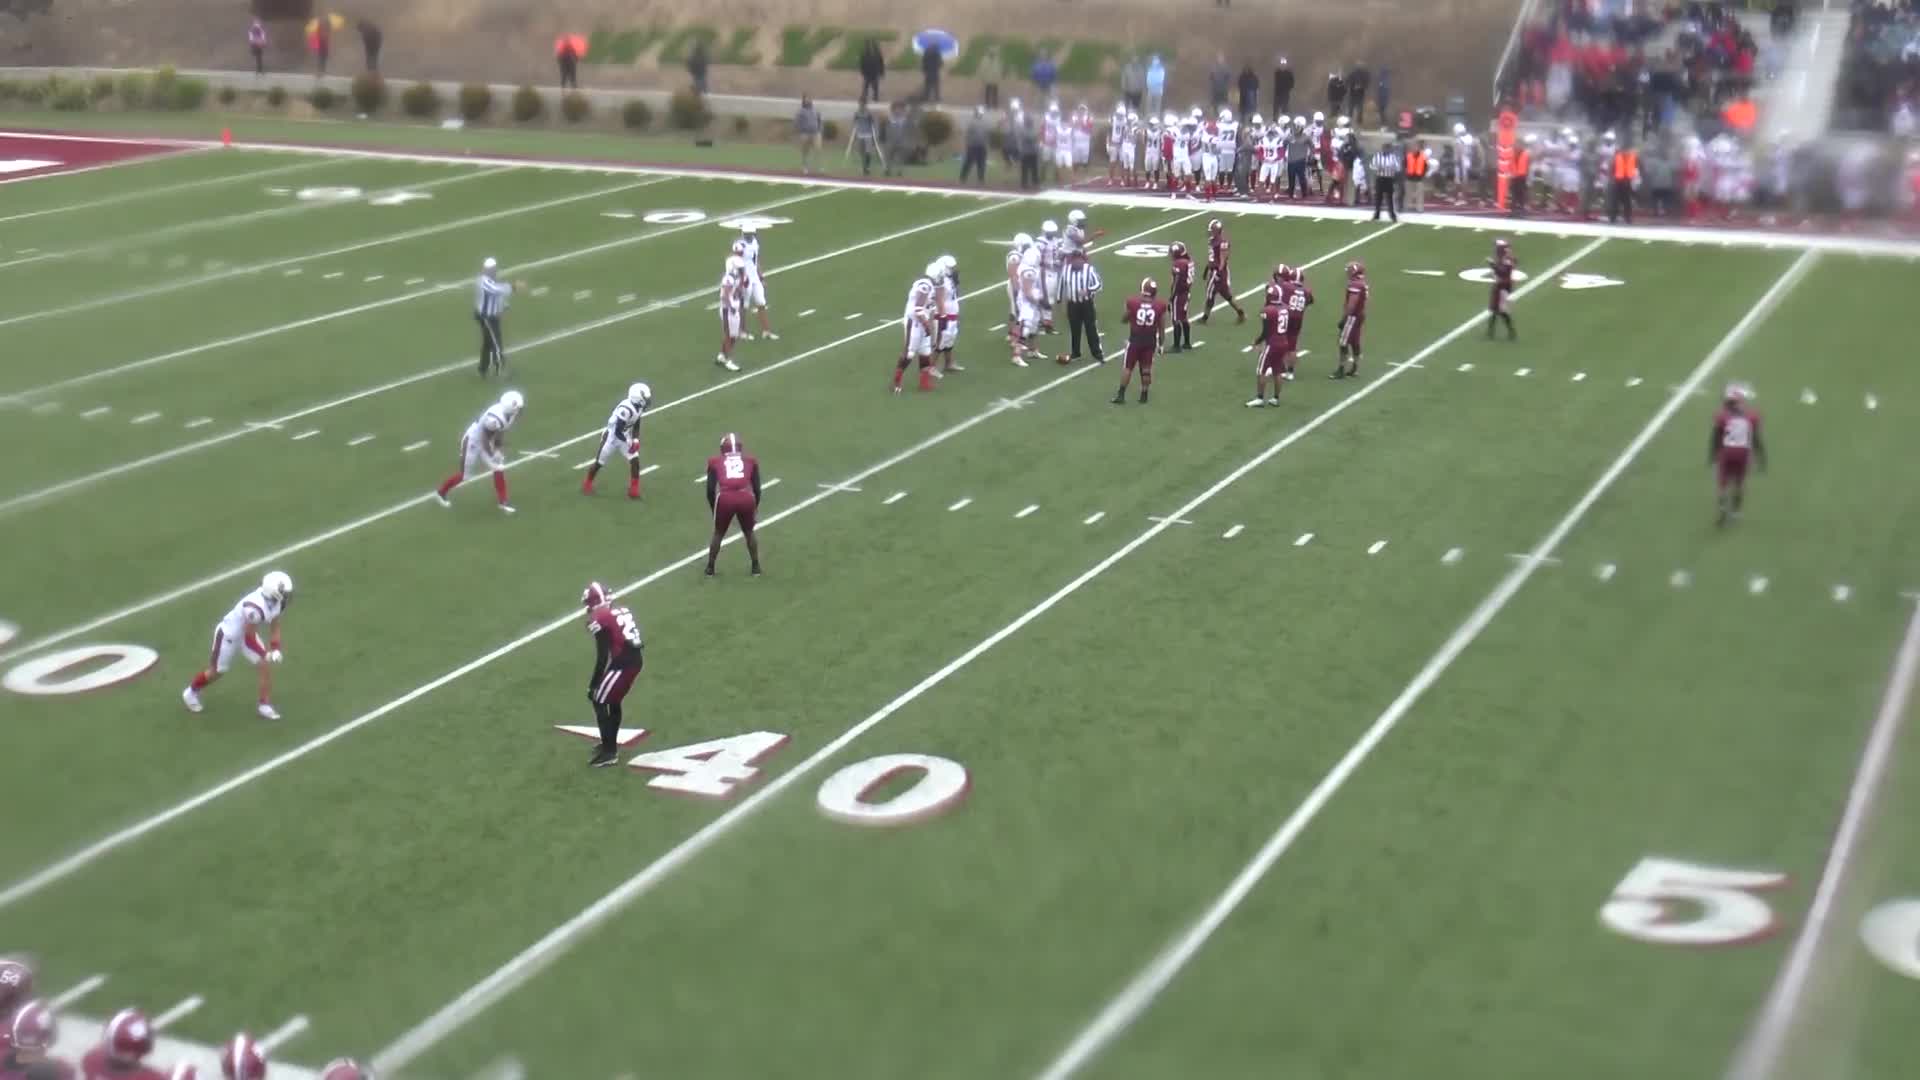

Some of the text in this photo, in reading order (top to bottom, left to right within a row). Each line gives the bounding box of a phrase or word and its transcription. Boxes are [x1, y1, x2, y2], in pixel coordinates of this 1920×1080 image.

[1136, 308, 1155, 326] 93
[1277, 314, 1289, 334] 21
[724, 459, 744, 478] 12
